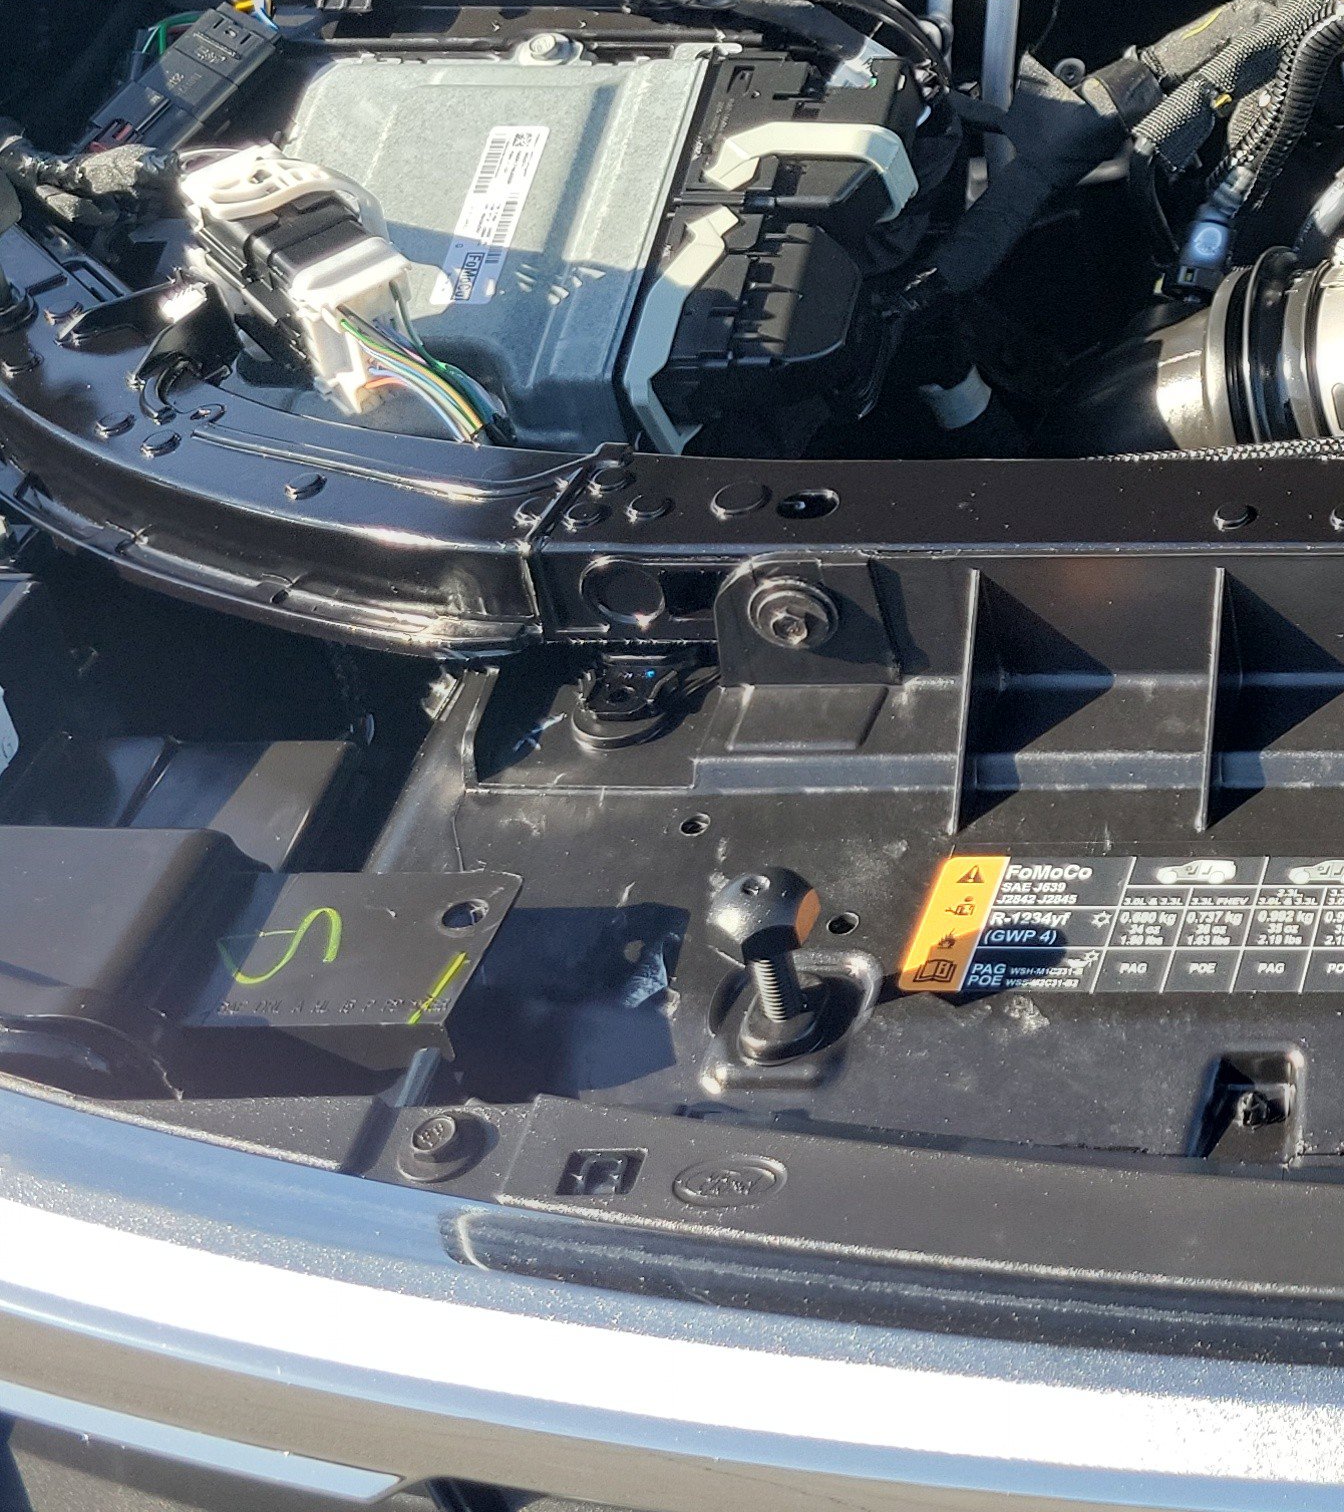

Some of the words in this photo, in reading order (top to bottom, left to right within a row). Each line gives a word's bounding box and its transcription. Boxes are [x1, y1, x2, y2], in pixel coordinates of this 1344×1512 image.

[1005, 864, 1093, 880] FoMoCo
[1001, 882, 1032, 893] SAE
[1033, 882, 1067, 893] J639
[997, 895, 1036, 904] J2842
[1037, 895, 1078, 904] J2845
[990, 912, 1072, 927] R-1234yf
[1159, 911, 1177, 926] kg
[1186, 911, 1224, 923] 0.737
[1224, 911, 1243, 926] kg
[1296, 911, 1314, 926] kg
[1145, 925, 1162, 935] oz
[1212, 925, 1228, 935] oz
[1284, 925, 1299, 934] oz
[984, 929, 1036, 944] (GWP
[1040, 930, 1057, 945] 4)
[1145, 935, 1164, 945] lbs
[1211, 935, 1231, 945] lbs
[1284, 934, 1302, 945] lbs
[972, 963, 1006, 974] PAG
[1120, 962, 1148, 974] PAG
[1189, 962, 1217, 974] POE
[1258, 962, 1285, 973] PAG
[967, 975, 1003, 986] POE
